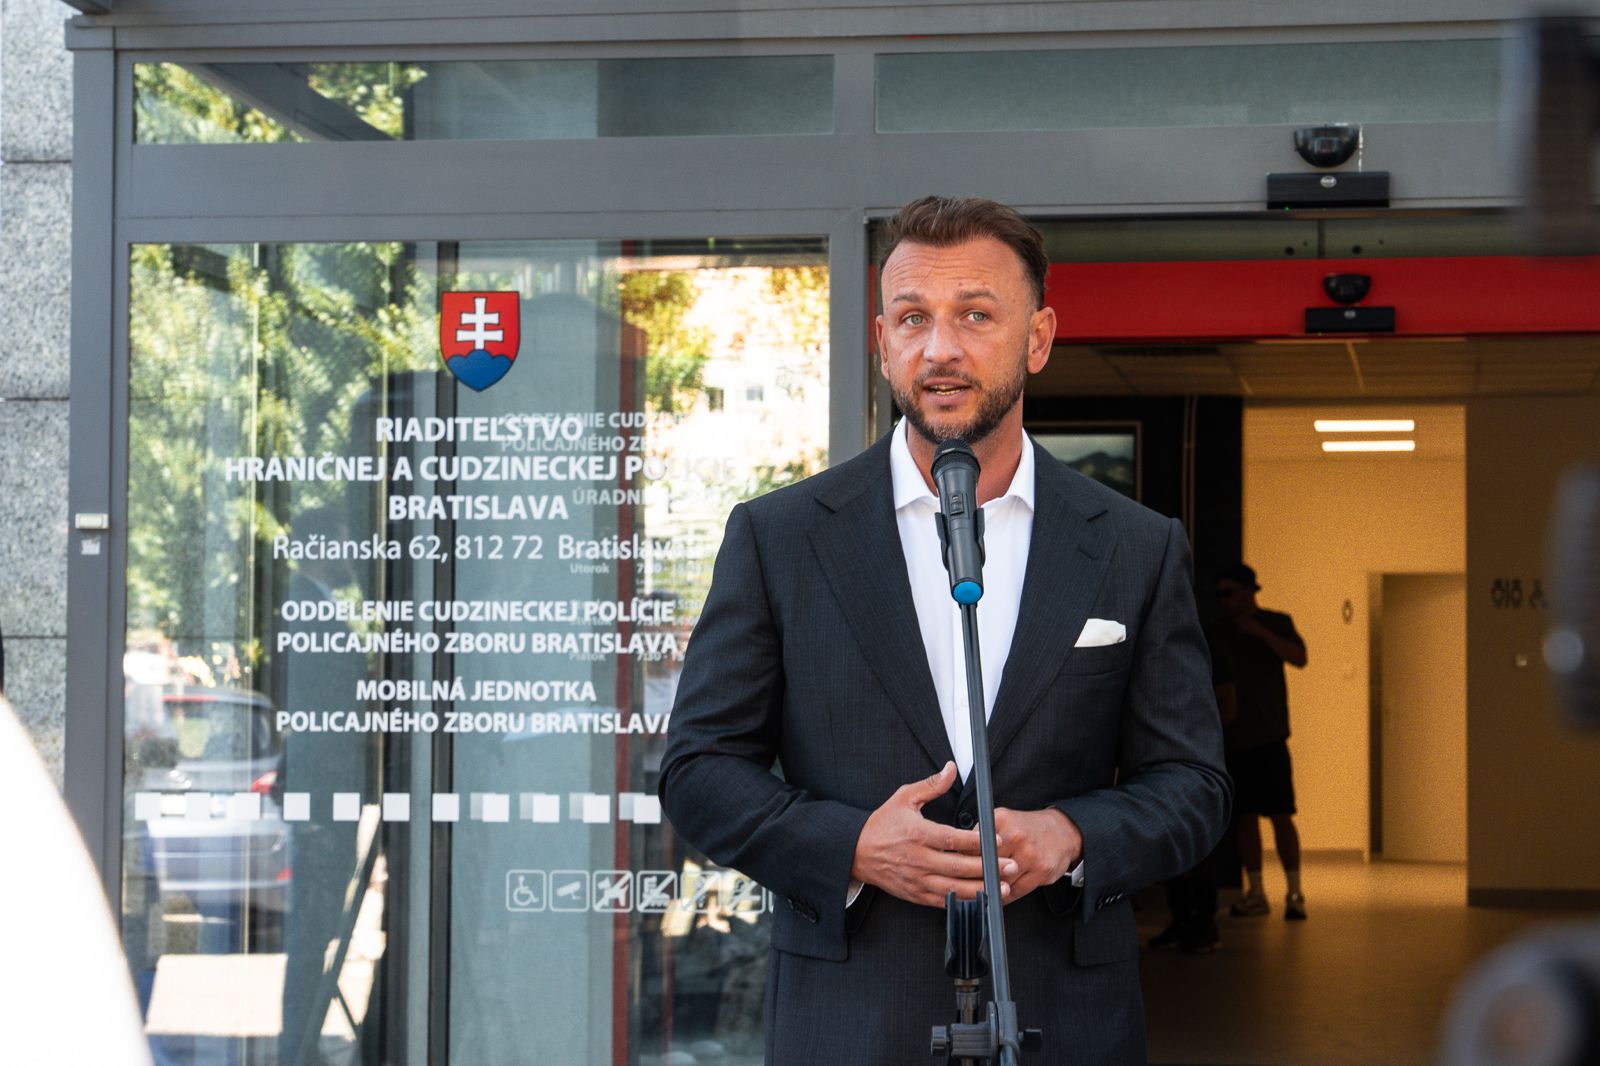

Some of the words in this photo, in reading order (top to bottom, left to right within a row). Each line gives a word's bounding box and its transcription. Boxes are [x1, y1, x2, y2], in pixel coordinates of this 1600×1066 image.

[376, 416, 584, 442] RIADITEĽSTVO
[225, 452, 387, 481] HRANIČNEJ
[392, 456, 413, 481] A
[419, 455, 618, 481] CUDZINECKEJ
[389, 495, 569, 520] BRATISLAVA
[273, 533, 402, 560] Račianska
[408, 535, 448, 564] 62,
[454, 535, 503, 560] 812
[512, 535, 544, 560] 72
[558, 533, 687, 560] Bratislava
[281, 600, 414, 622] ODDELENIE
[419, 600, 578, 622] CUDZINECKEJ
[584, 597, 676, 622] POLÍCIE
[277, 628, 440, 653] POLICAJNÉHO
[444, 632, 525, 653] ZBORU
[531, 632, 678, 654] BRATISLAVA
[356, 676, 466, 701] MOBILNÁ
[470, 680, 597, 702] JEDNOTKA
[276, 707, 439, 733] POLICAJNÉHO
[443, 711, 525, 733] ZBORU
